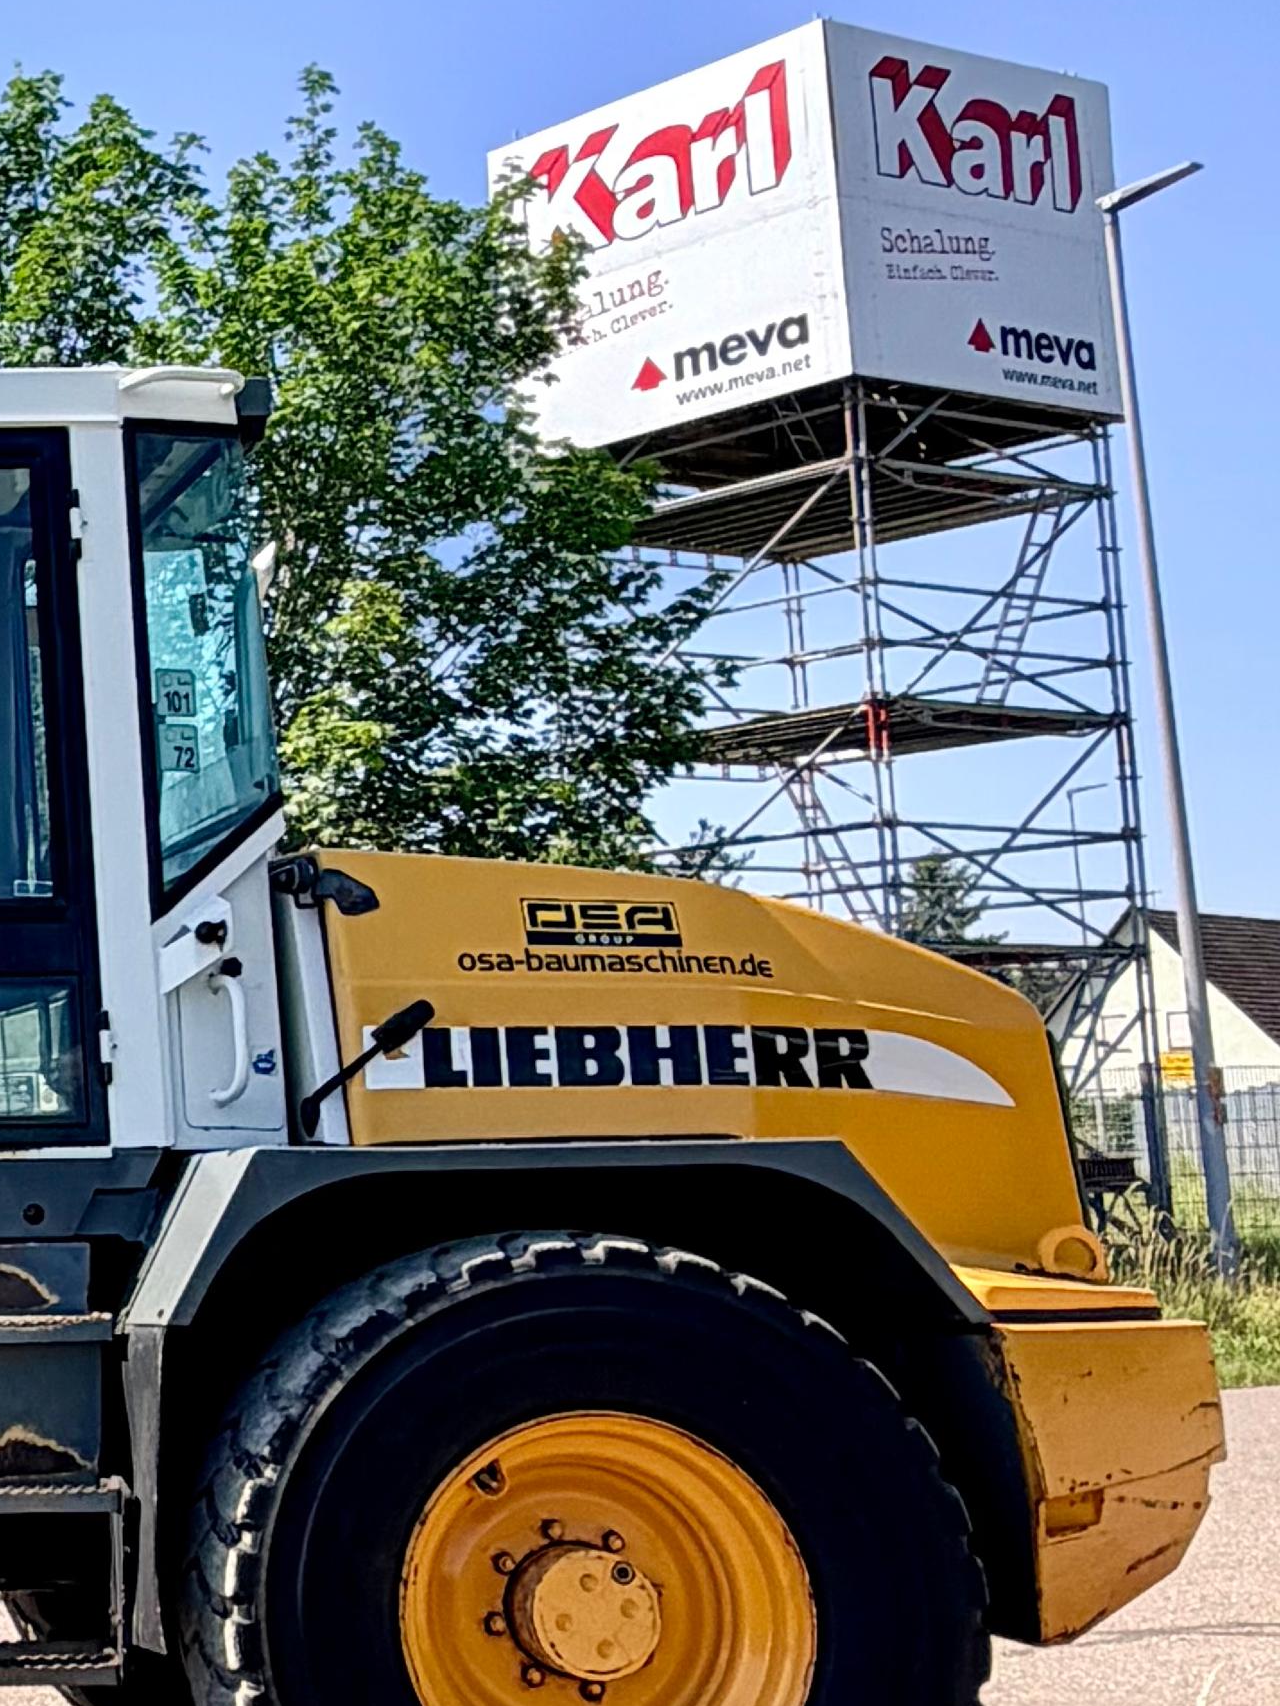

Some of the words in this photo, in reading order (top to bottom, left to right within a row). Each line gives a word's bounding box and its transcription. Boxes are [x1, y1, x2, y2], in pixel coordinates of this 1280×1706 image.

[523, 59, 792, 254] Karl
[869, 56, 1082, 213] Karl
[570, 269, 670, 324] alung.
[610, 300, 674, 334] Clever.
[673, 313, 809, 382] meva
[1000, 325, 1096, 371] meva
[676, 354, 811, 405] www.meva.net
[1002, 368, 1098, 395] www.meva.net
[164, 691, 190, 712] 101
[174, 746, 195, 767] 72
[575, 933, 634, 944] GROUP
[458, 948, 774, 978] osa-baumaschinen.de
[422, 1024, 874, 1090] LIEBHERR
